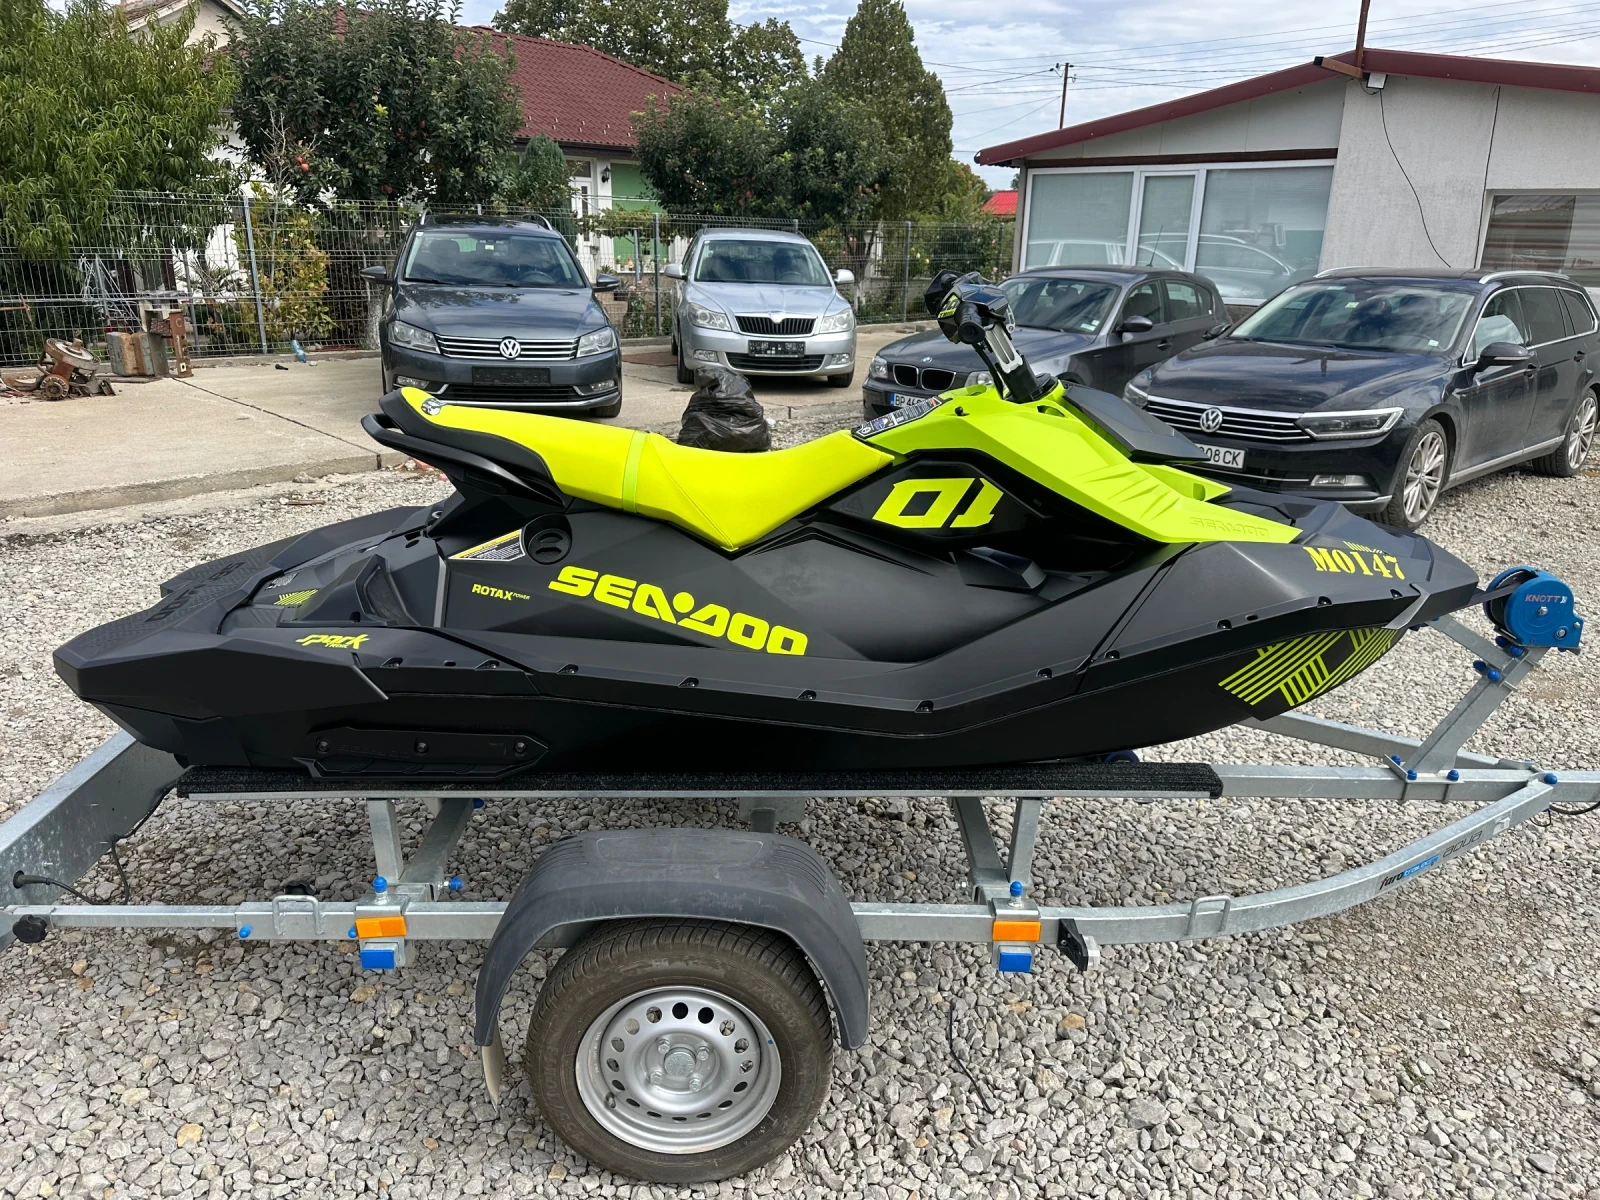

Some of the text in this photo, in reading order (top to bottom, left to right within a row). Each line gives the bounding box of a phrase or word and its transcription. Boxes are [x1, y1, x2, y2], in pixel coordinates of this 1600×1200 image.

[1222, 450, 1241, 466] CK
[471, 583, 531, 601] ROTAX POWER
[1525, 594, 1561, 603] KNOTT
